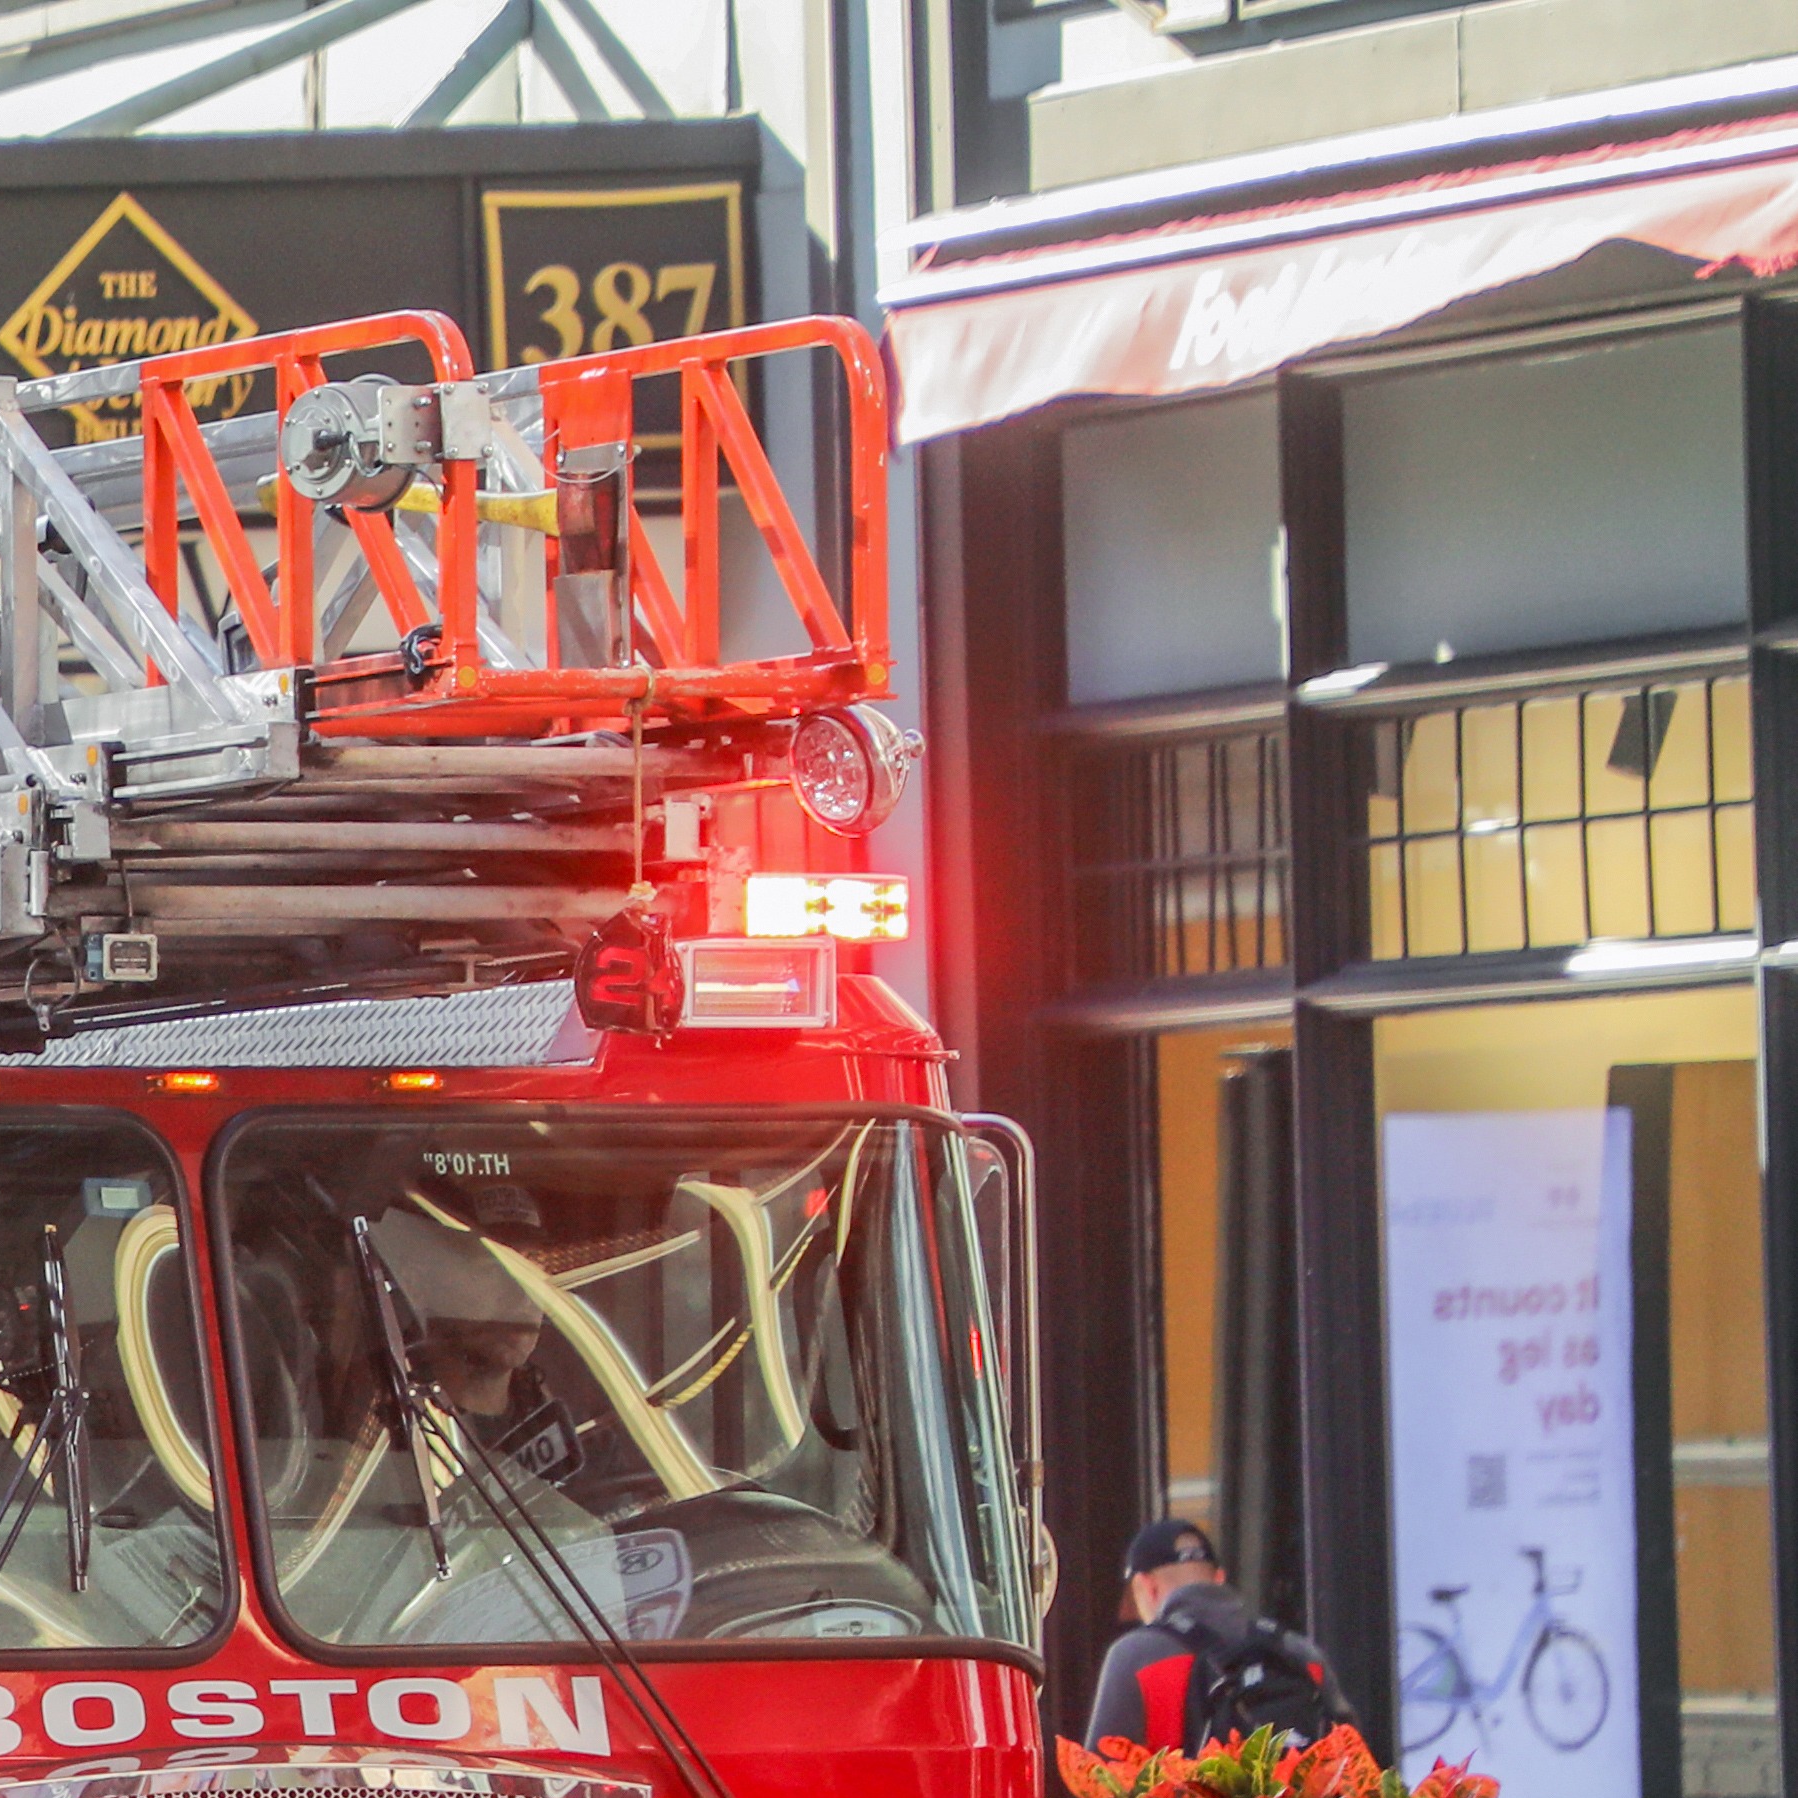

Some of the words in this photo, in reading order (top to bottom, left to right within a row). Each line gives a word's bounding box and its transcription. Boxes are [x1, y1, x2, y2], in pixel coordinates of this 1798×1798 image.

[99, 270, 157, 298] THE
[22, 304, 232, 357] Diamond
[521, 261, 717, 365] 387
